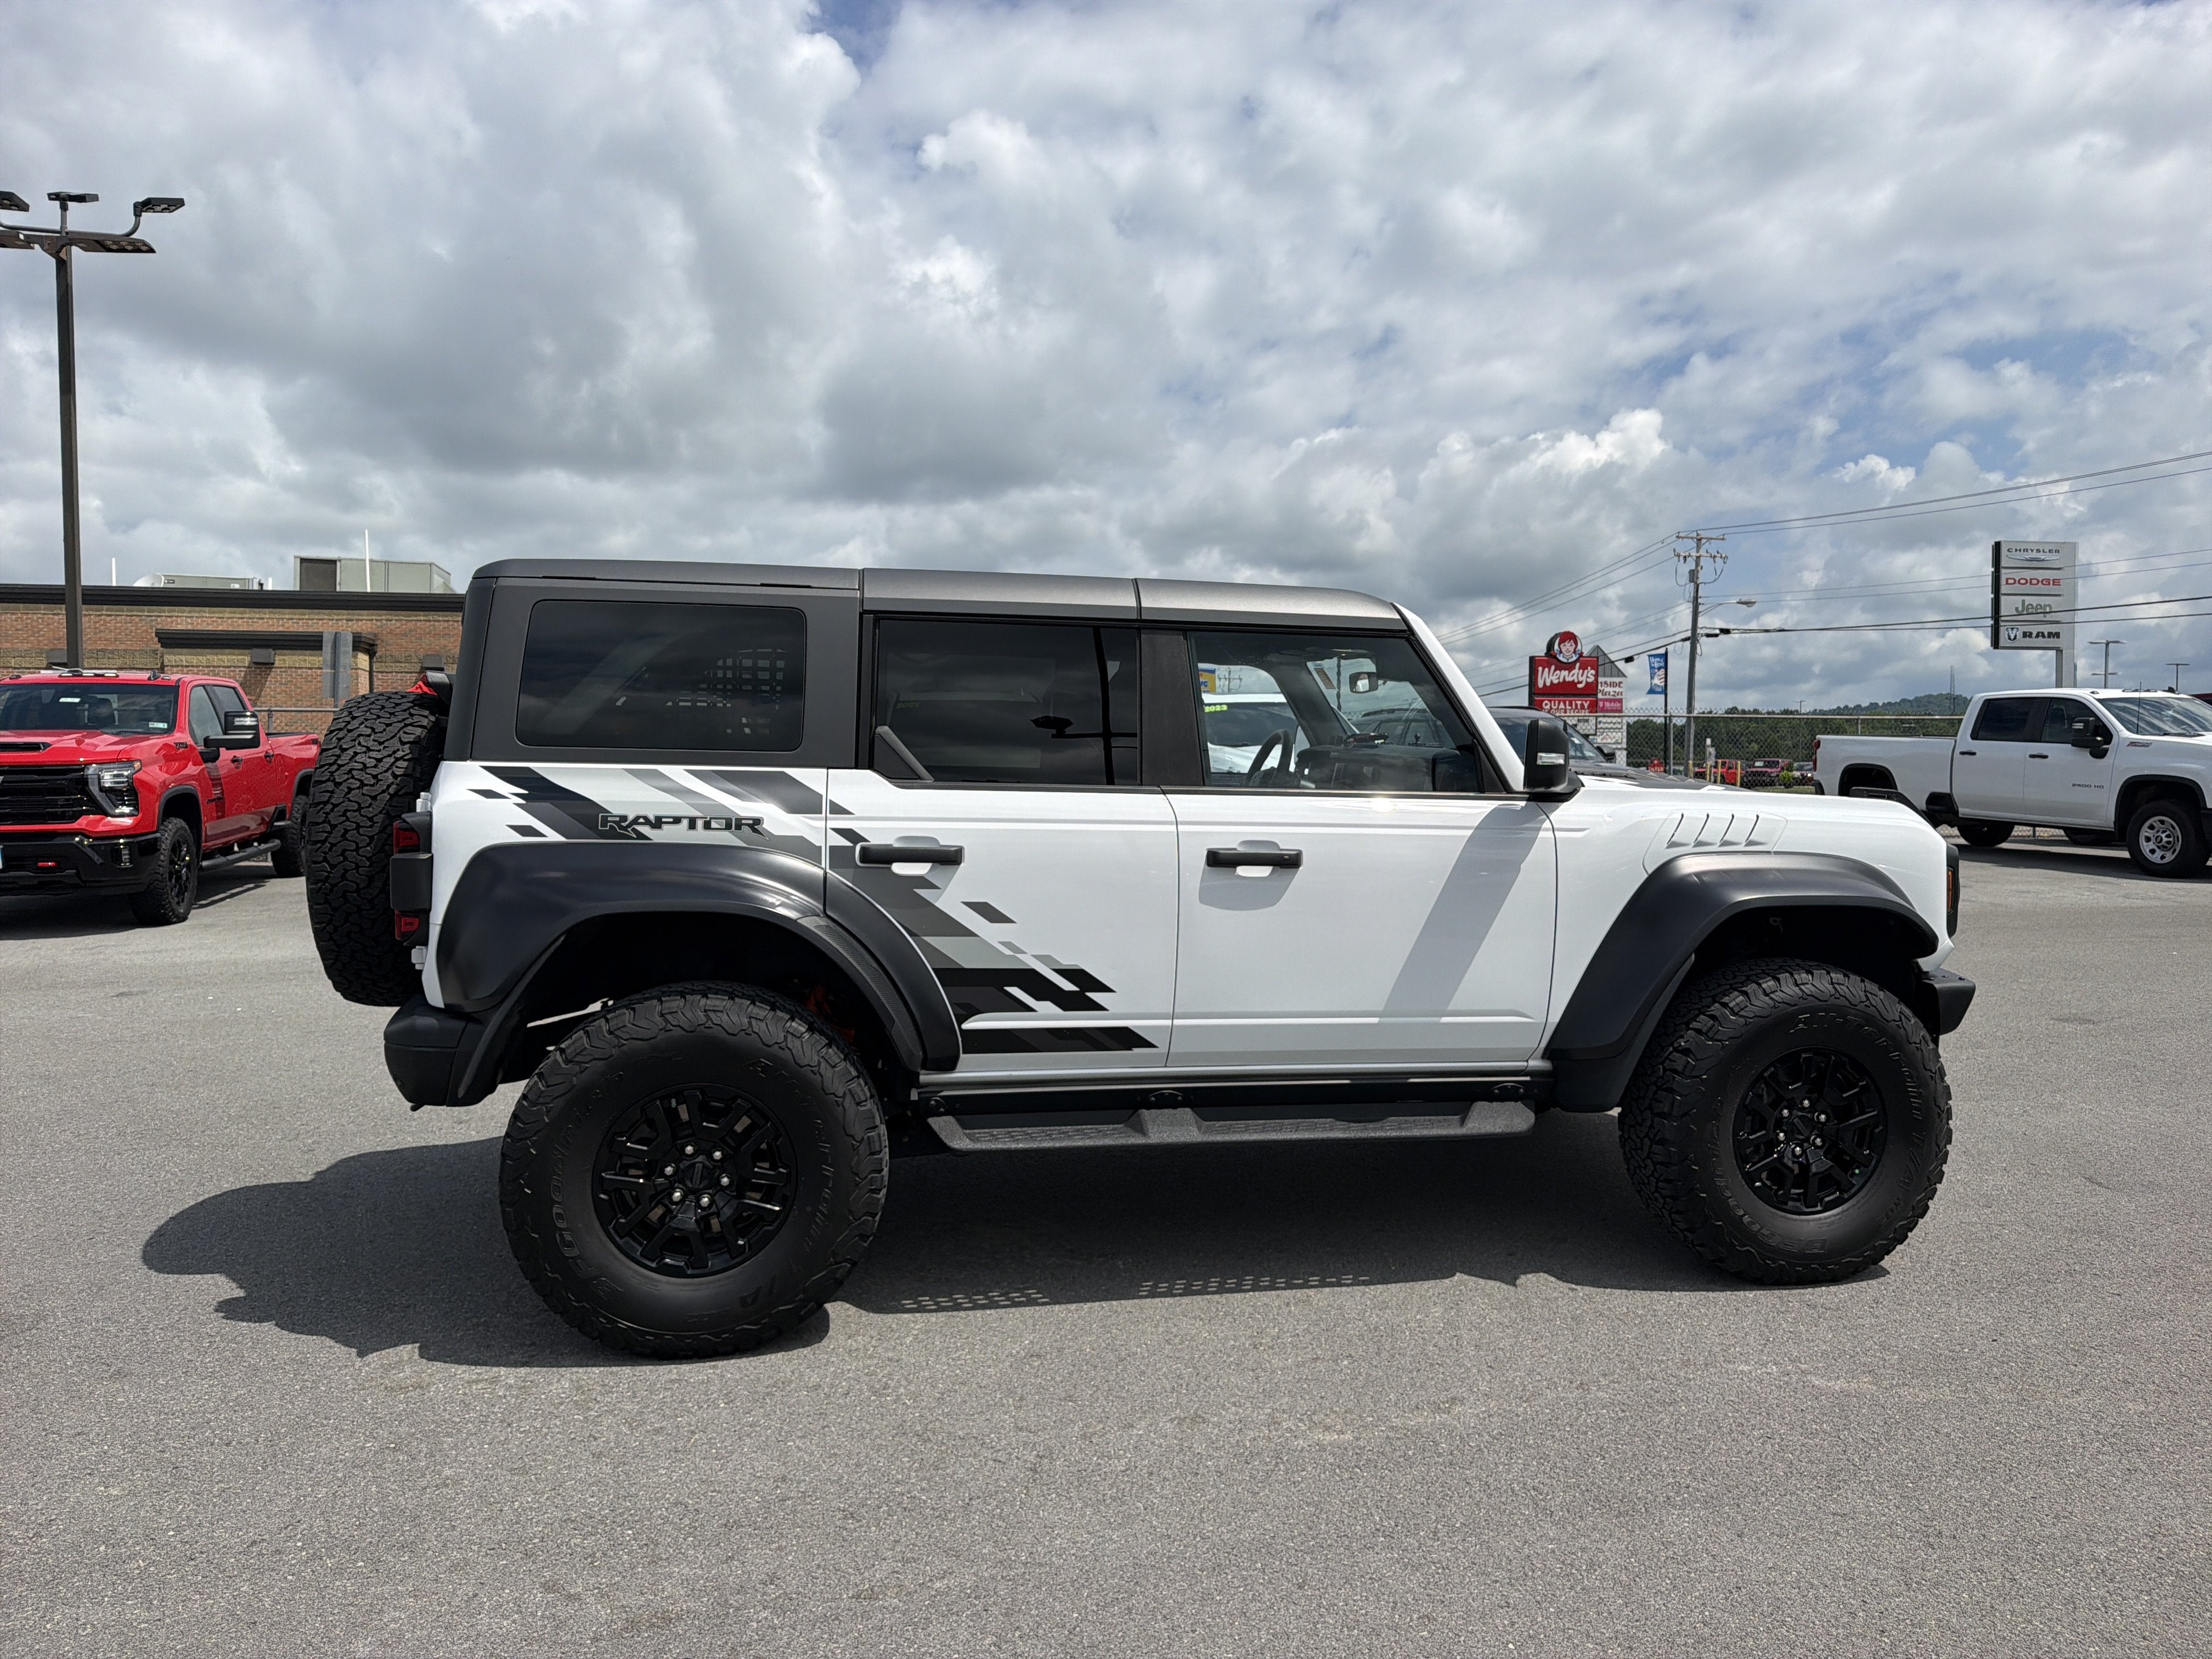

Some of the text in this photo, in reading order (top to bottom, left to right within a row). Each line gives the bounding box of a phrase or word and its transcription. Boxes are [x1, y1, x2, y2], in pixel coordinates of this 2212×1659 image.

[2005, 578, 2062, 586] DODGE
[2015, 599, 2053, 618] Jeep
[2022, 631, 2061, 639] RAM
[1537, 662, 1595, 689] Wendy's
[1204, 704, 1228, 713] 2023
[1542, 700, 1589, 709] QUALITY
[599, 813, 770, 841] RAPTOR
